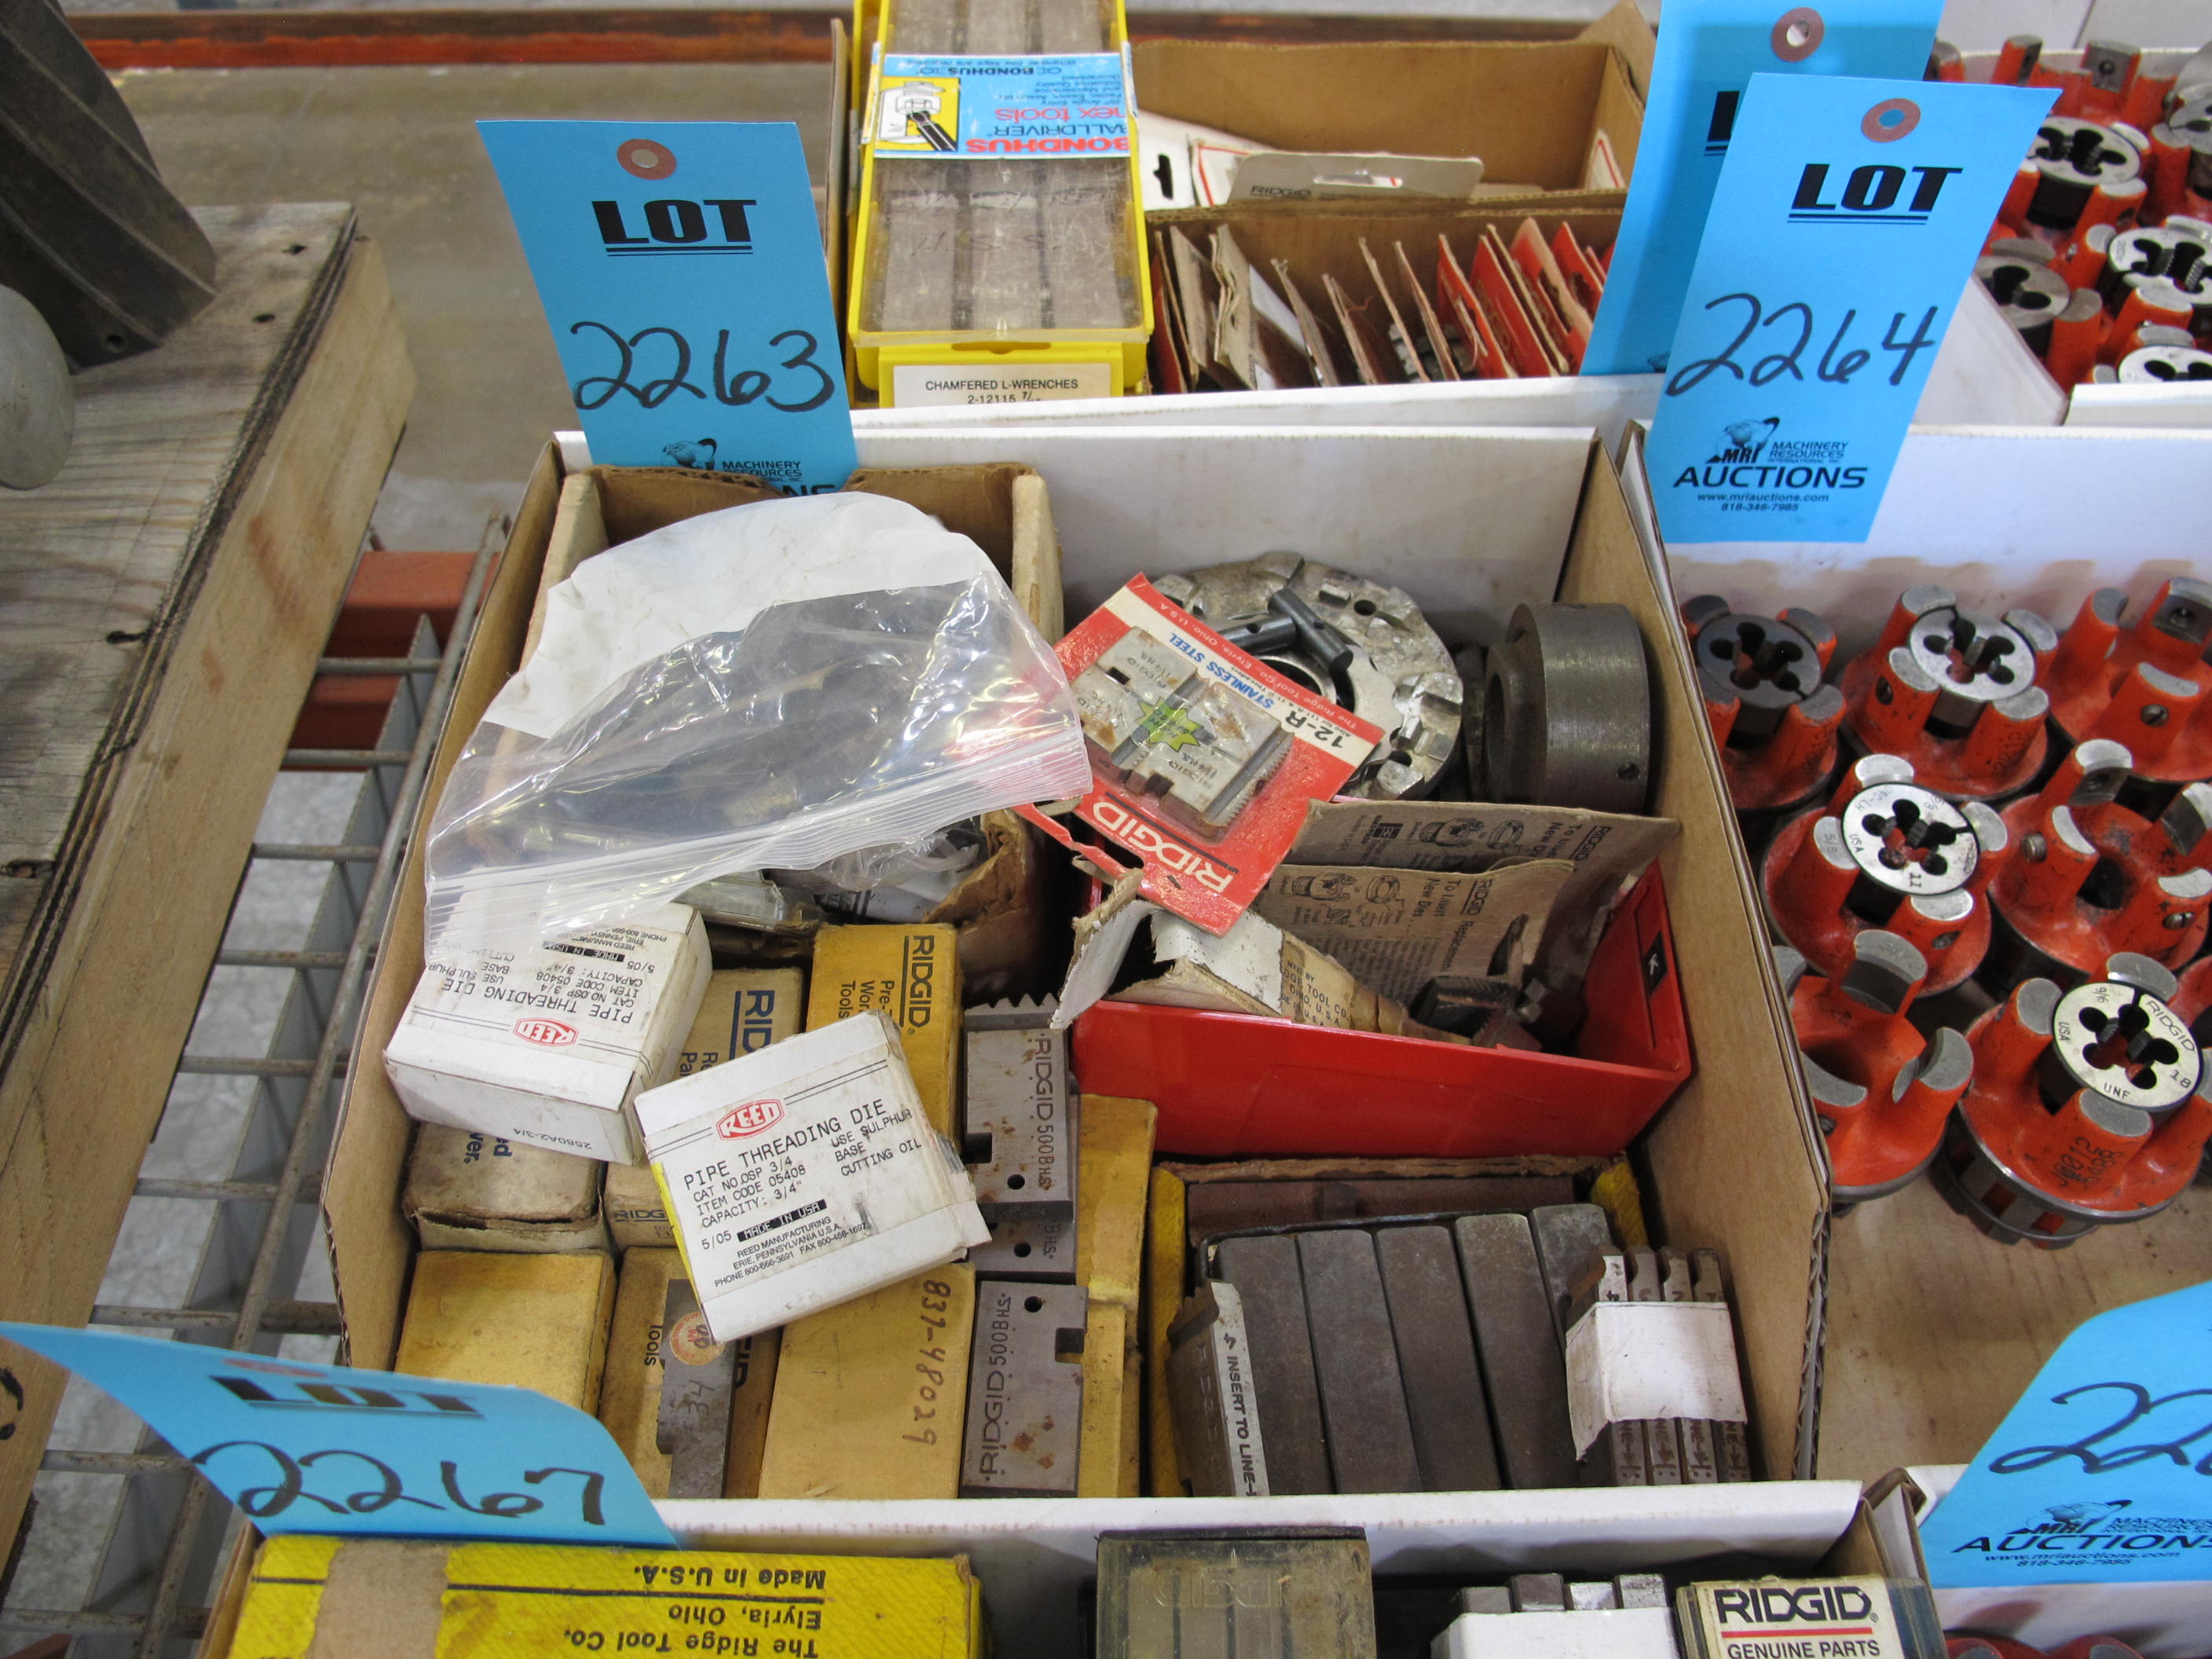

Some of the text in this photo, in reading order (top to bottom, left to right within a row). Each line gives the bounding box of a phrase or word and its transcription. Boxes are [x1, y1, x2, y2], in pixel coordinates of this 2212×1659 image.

[948, 66, 1035, 76] BONDHUS
[994, 107, 1071, 123] tools
[1791, 163, 1963, 213] LOT
[591, 200, 757, 244] LOT
[1664, 293, 1938, 396] 2264
[570, 321, 835, 412] 2263
[925, 379, 1079, 391] CHAMFERED L-WRENCHES
[1769, 450, 1845, 459] RESOURCES
[1771, 441, 1848, 450] MACHINERY
[722, 460, 802, 470] MACHINERY
[1672, 467, 1869, 489] AUCTIONS
[1697, 493, 1829, 502] www.mriauctions.com
[1169, 632, 1275, 709] STAINLESS STEEL
[1303, 696, 1336, 717] Ridge
[1337, 714, 1357, 729] The
[1285, 711, 1344, 749] 12-R
[1093, 801, 1234, 893] RIDGID
[1576, 825, 1610, 861] RIDGID
[1848, 833, 1865, 854] USA
[1426, 877, 1441, 894] New
[1464, 878, 1492, 916] RIDGID
[592, 949, 620, 961] MADE
[626, 961, 656, 974] 5/05
[481, 961, 639, 1000] ITEM CODE 05408 BASE
[482, 972, 504, 984] USE
[540, 983, 562, 994] 3/4
[583, 967, 643, 987] CAPACITY:
[908, 934, 935, 1030] RIDGID
[442, 976, 634, 1024] PIPE THREADING DIE
[613, 997, 634, 1009] CAT
[837, 980, 857, 1020] Tools
[1307, 983, 1331, 1008] TOOL
[517, 1019, 577, 1046] REED
[2058, 1021, 2071, 1042] USA
[2146, 1000, 2196, 1053] RIDGID
[1035, 1037, 1054, 1122] RIDGID
[2104, 1082, 2131, 1101] UNF
[2169, 1069, 2192, 1090] 18
[720, 1101, 780, 1139] REED
[683, 1098, 888, 1191] PIPE THREADING DIE
[693, 1185, 715, 1203] CAT
[769, 1156, 793, 1174] 3/4
[831, 1133, 855, 1148] USE
[860, 1108, 914, 1137] SULPHUR
[697, 1141, 867, 1217] ITEM CODE 05408 BASE
[701, 1137, 923, 1229] CAPACITY: 3/4" CUTTING OIL
[614, 1210, 665, 1218] RIDG
[701, 1230, 732, 1251] 5/05
[743, 1221, 774, 1240] MADE
[797, 1202, 820, 1219] USA
[733, 1255, 755, 1270] ERIE,
[756, 1231, 819, 1263] PENNSYLVANIA
[737, 1216, 832, 1258] REED MANUFACTURING
[714, 1269, 744, 1288] PHONE
[800, 1241, 817, 1255] FAX
[1226, 1355, 1247, 1415] INSERT
[979, 1369, 1005, 1476] RIDGID
[1236, 1416, 1250, 1440] TO
[1239, 1443, 1257, 1484] LINE
[192, 1441, 607, 1525] 2267
[633, 1564, 827, 1590] Made in U.S.A.
[668, 1602, 822, 1630] Elyria, Ohio
[1713, 1585, 1873, 1624] RIDGID
[562, 1628, 819, 1659] The Ridge Tool Co.
[1727, 1639, 1881, 1659] GENUINE PARTS
